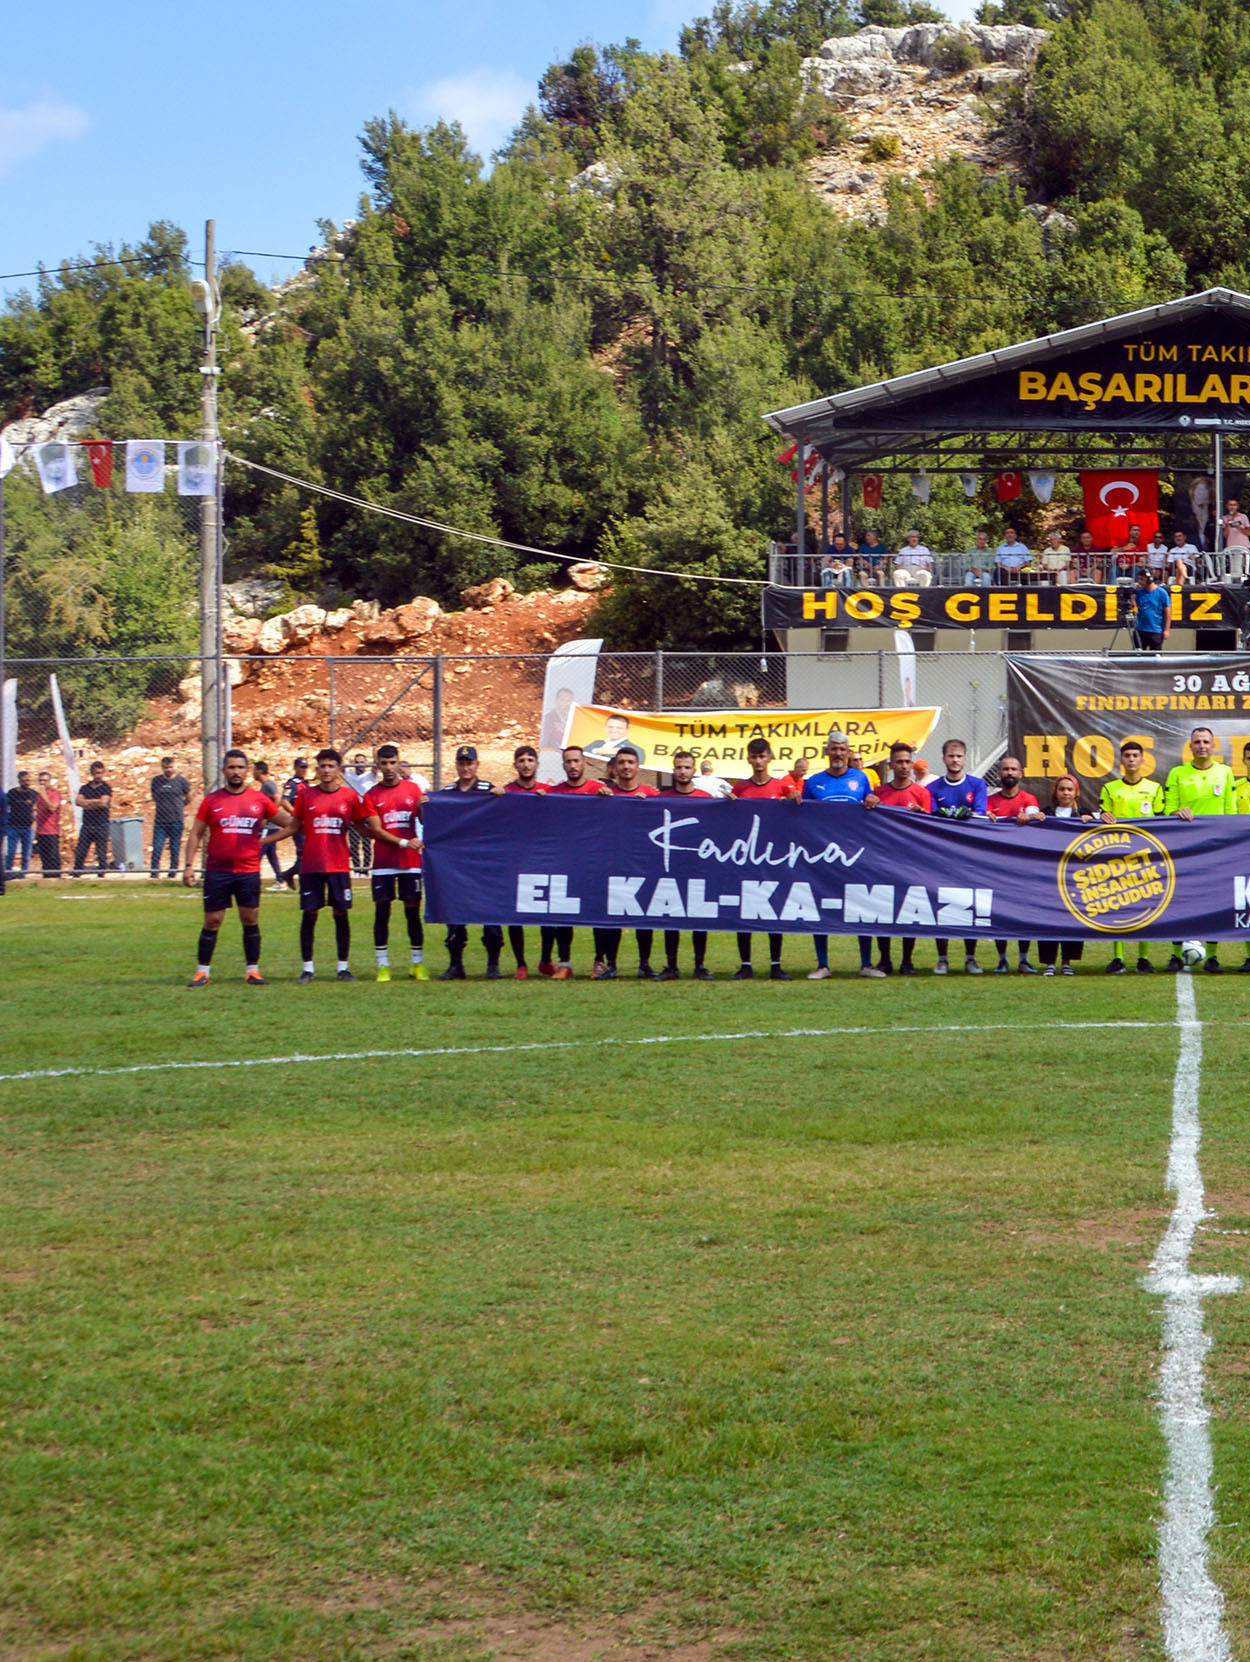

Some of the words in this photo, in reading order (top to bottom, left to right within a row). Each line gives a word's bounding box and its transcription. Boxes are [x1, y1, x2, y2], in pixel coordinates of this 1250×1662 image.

[1123, 341, 1178, 362] TÜM
[802, 591, 920, 628] HOŞ
[945, 585, 1223, 622] GELDİİZ
[1173, 675, 1202, 692] 30
[1076, 695, 1236, 710] FINDIKPINARI
[675, 720, 727, 739] TÜM
[736, 721, 878, 738] TAKIMLARA
[220, 815, 258, 828] GÜNEY
[648, 808, 865, 872] Kadına
[1075, 832, 1132, 859] KADINA
[1080, 865, 1161, 904] İNSANLIK
[516, 873, 581, 914] EL
[607, 875, 994, 927] KAL-KA-MAZ!
